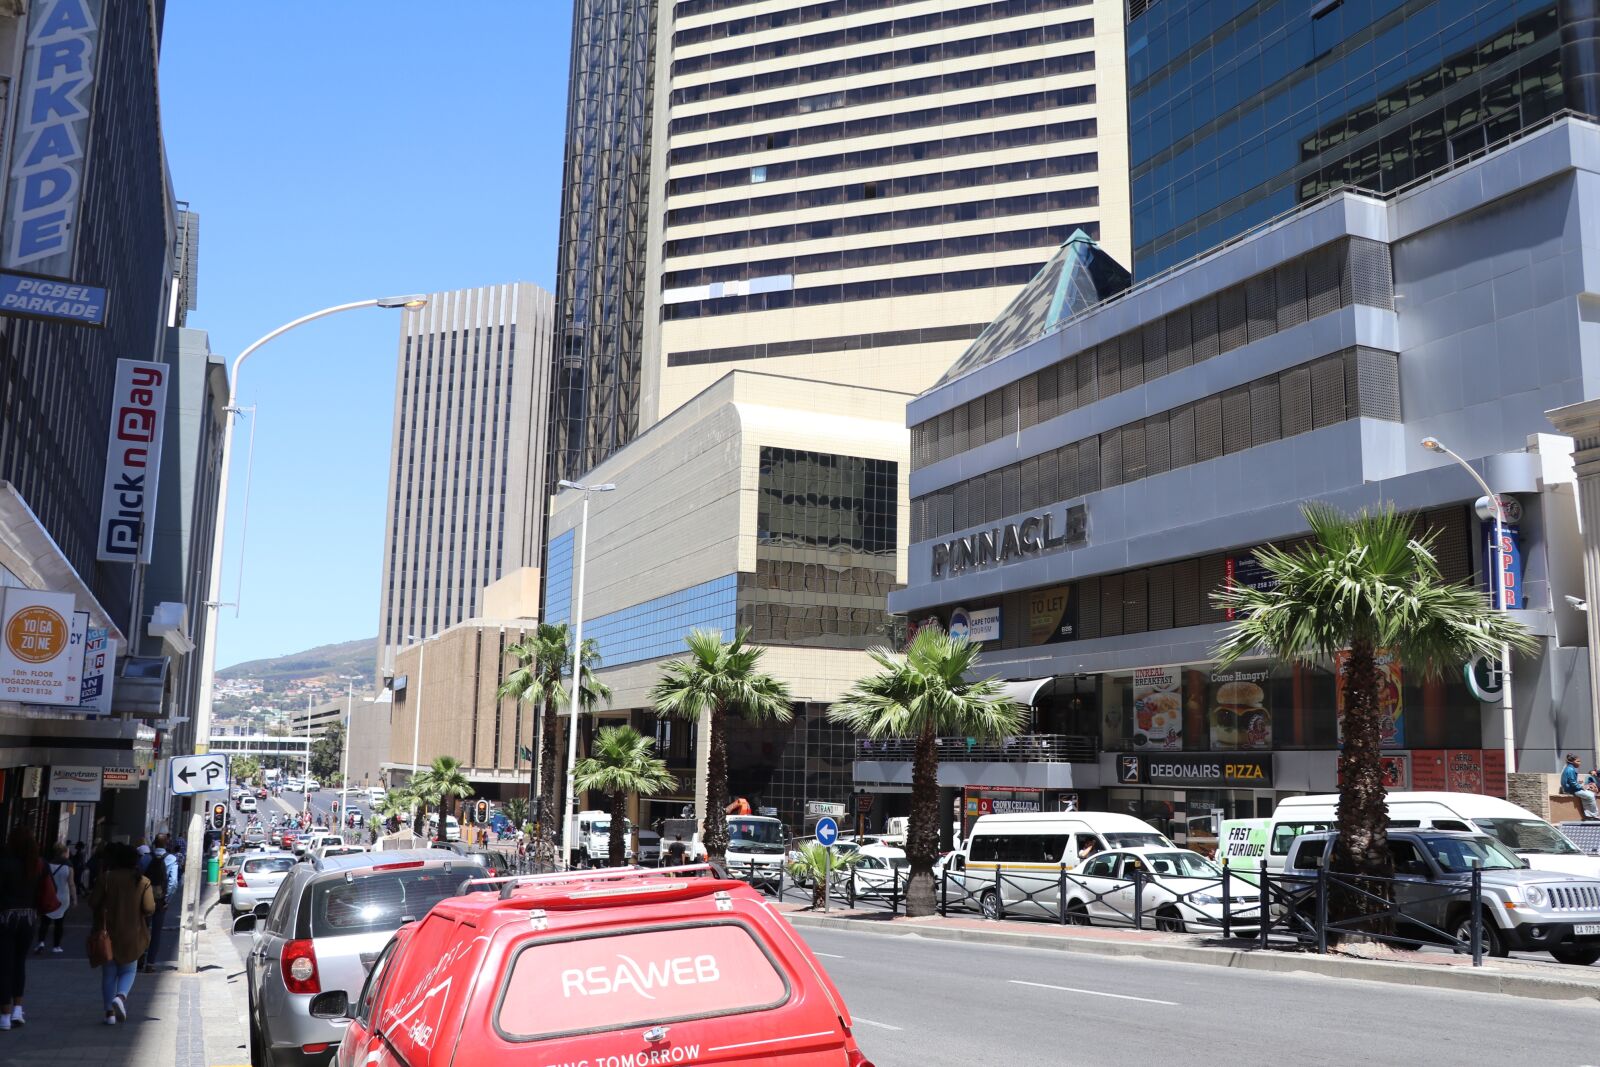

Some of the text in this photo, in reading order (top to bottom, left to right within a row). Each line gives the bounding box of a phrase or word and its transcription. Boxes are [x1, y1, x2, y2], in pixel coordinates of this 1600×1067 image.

[16, 279, 91, 302] PICBEL
[2, 292, 100, 319] PARKADE
[106, 366, 163, 555] Pick n Pay
[931, 503, 1089, 578] PINNACLE
[1502, 536, 1516, 606] SPUR
[1031, 596, 1065, 614] TO LET
[971, 615, 1000, 627] CAPE TOWN
[971, 625, 993, 636] TOURISM
[31, 670, 54, 678] FLOOR
[1135, 668, 1165, 679] UNREAL
[1211, 670, 1269, 683] Come Hungry!
[1135, 675, 1173, 687] BREAKFAST
[1150, 764, 1264, 779] DEBONAIRS PIZZA
[814, 803, 833, 814] STRAND
[992, 800, 1012, 809] CROWN
[1229, 827, 1252, 841] FAST
[1227, 843, 1265, 857] FURIOUS
[561, 954, 720, 1000] RSAWEB
[595, 1044, 701, 1067] TOMORROW
